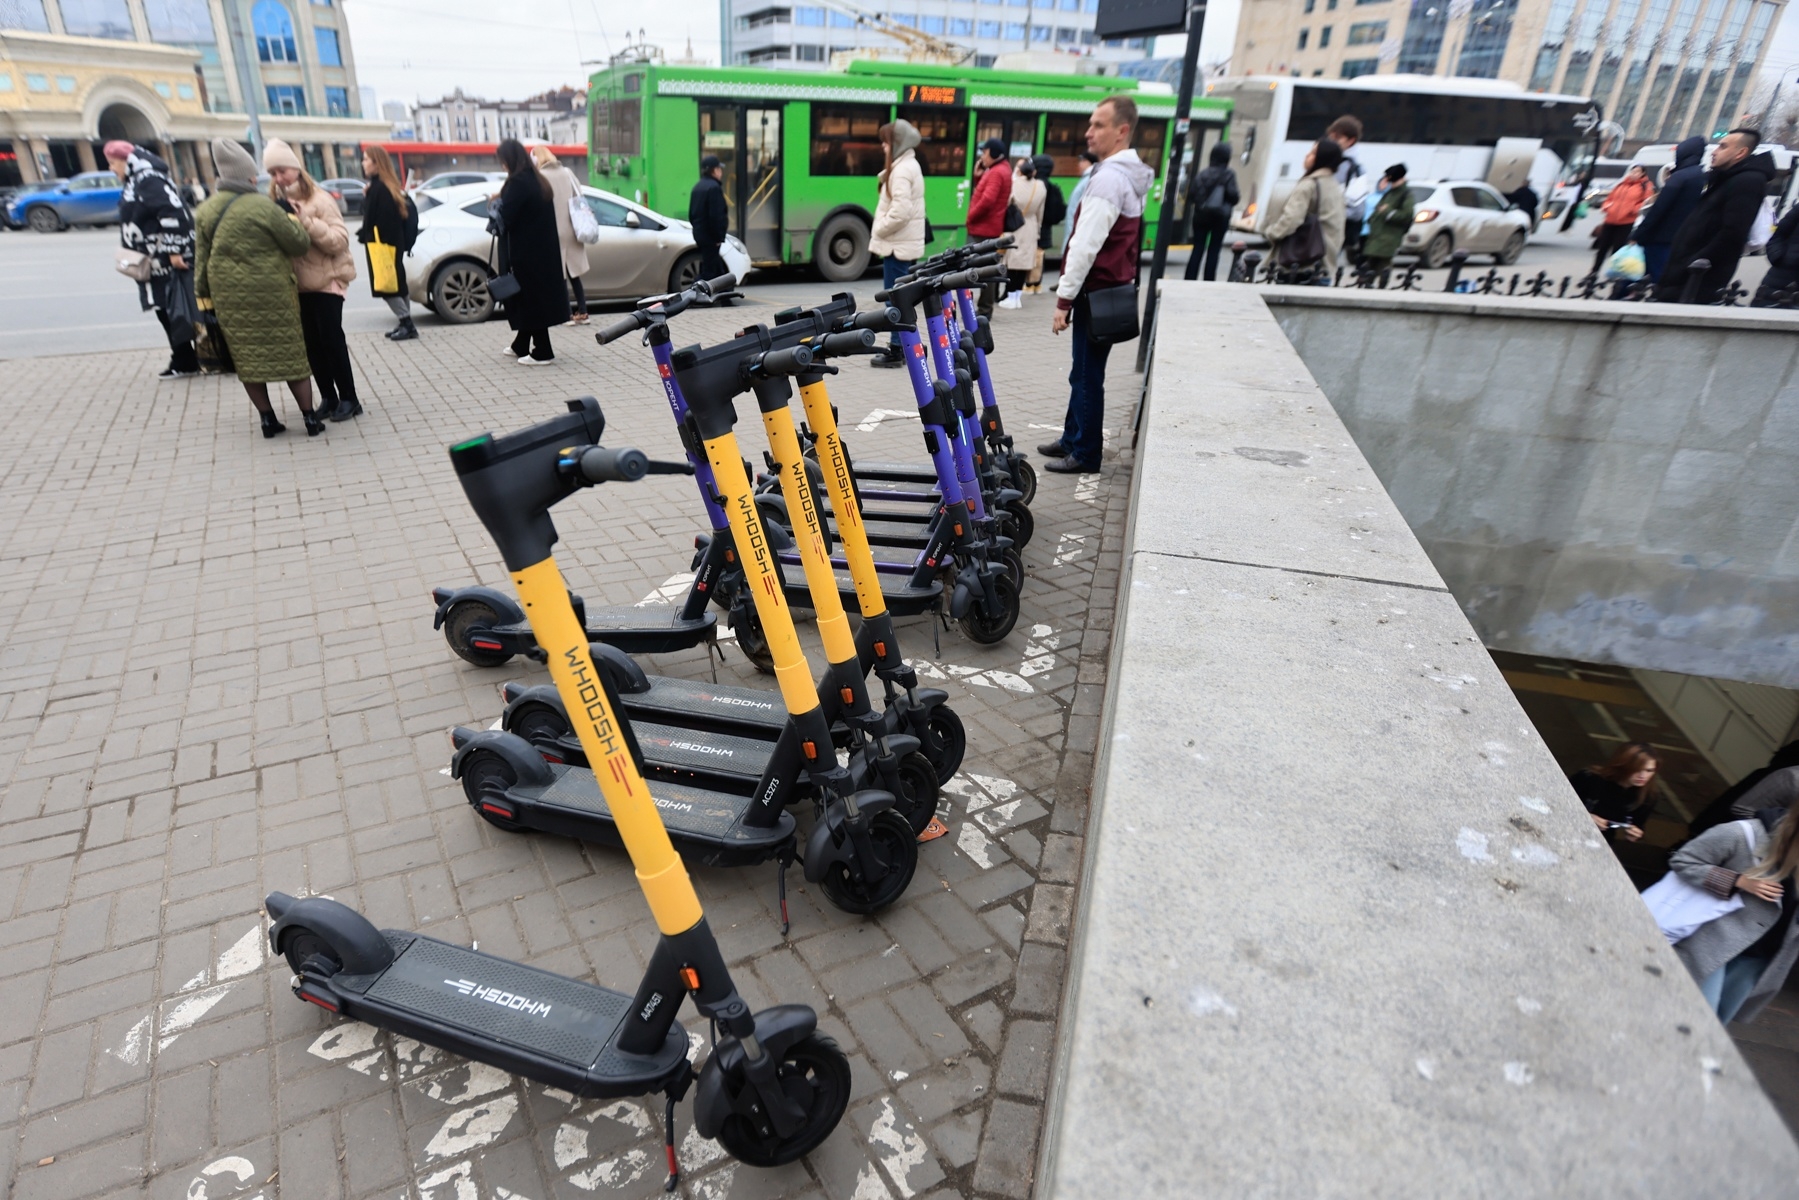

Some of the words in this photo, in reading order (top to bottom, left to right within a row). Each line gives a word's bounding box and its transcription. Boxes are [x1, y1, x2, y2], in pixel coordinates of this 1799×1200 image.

[920, 358, 932, 388] ЮРЕНТ
[944, 348, 954, 376] ЮРЕНТ
[664, 379, 680, 412] ЮРЕНТ
[826, 432, 852, 500] WHOOSH
[791, 461, 819, 535] WHOOSH
[737, 494, 771, 575] WHOOSH
[564, 645, 619, 756] WHOOSH
[712, 695, 773, 710] WHOOSH
[669, 736, 734, 757] WHOOSH
[761, 777, 780, 807] AC3273
[472, 984, 552, 1019] WHOOSH
